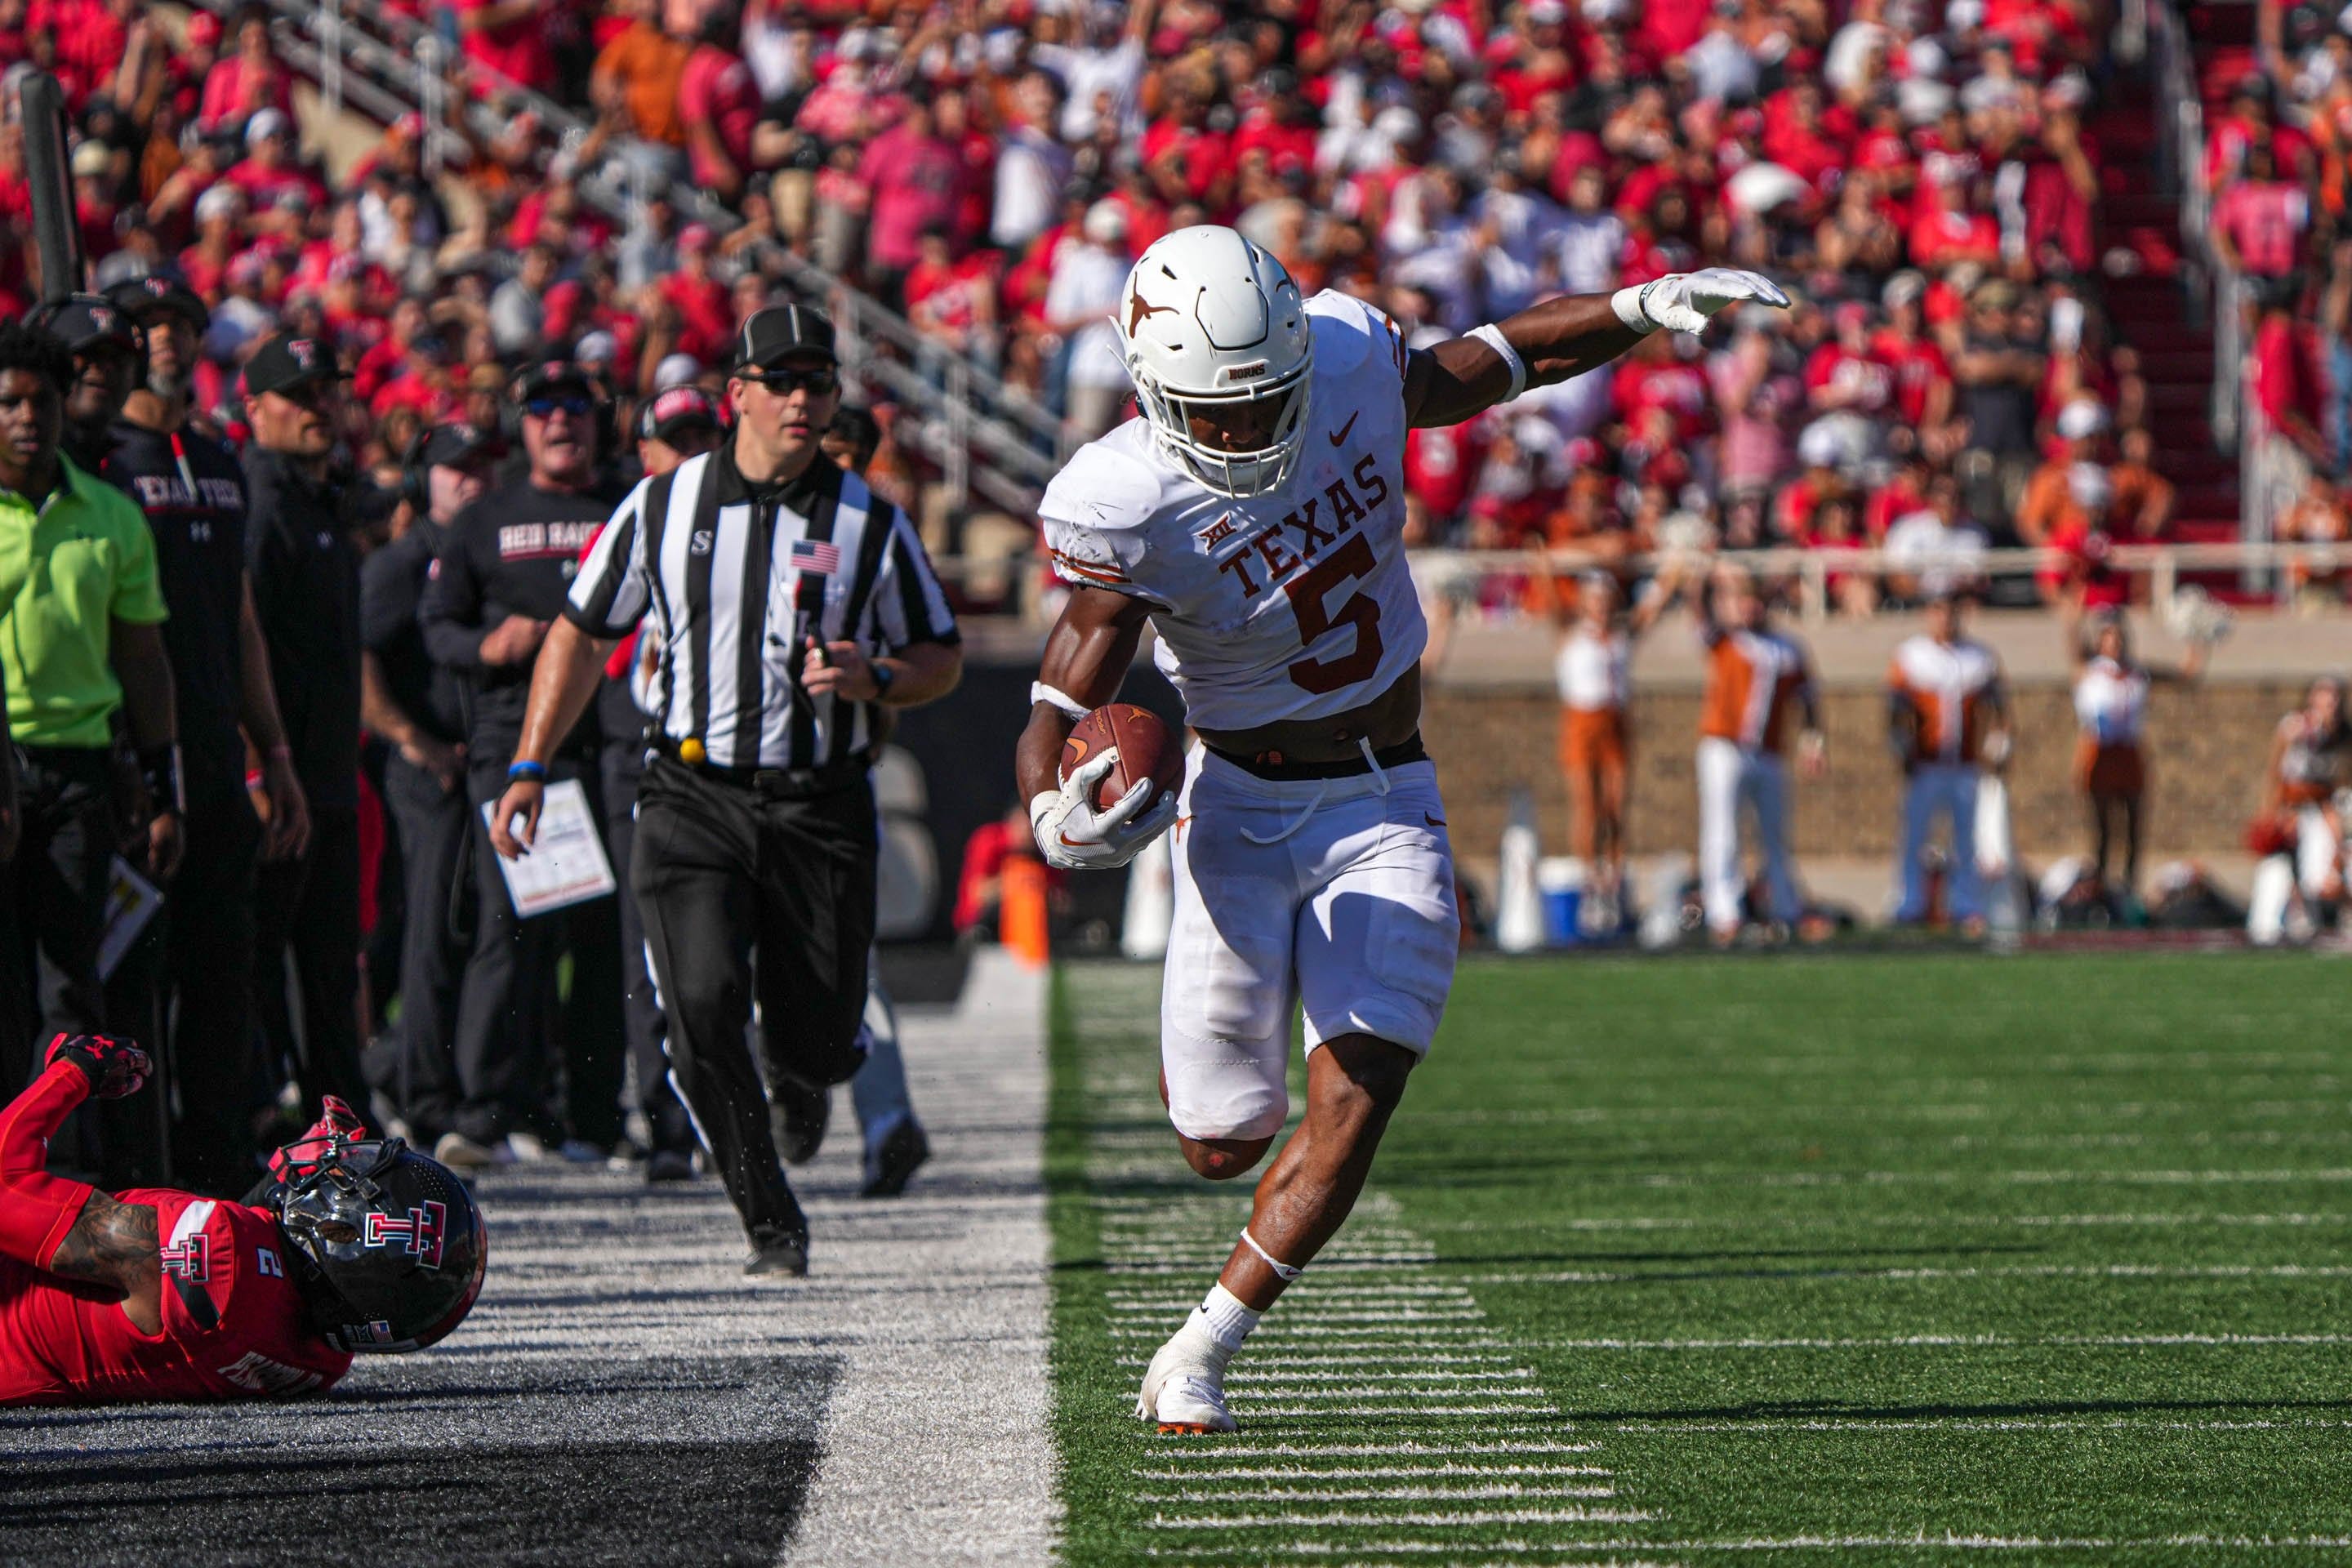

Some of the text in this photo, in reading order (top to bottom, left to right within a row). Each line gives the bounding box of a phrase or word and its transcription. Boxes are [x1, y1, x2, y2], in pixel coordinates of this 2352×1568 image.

[1227, 363, 1265, 381] HORNS
[1218, 453, 1388, 599] TEXAS
[1283, 531, 1384, 695] 5
[256, 1246, 284, 1279] 2
